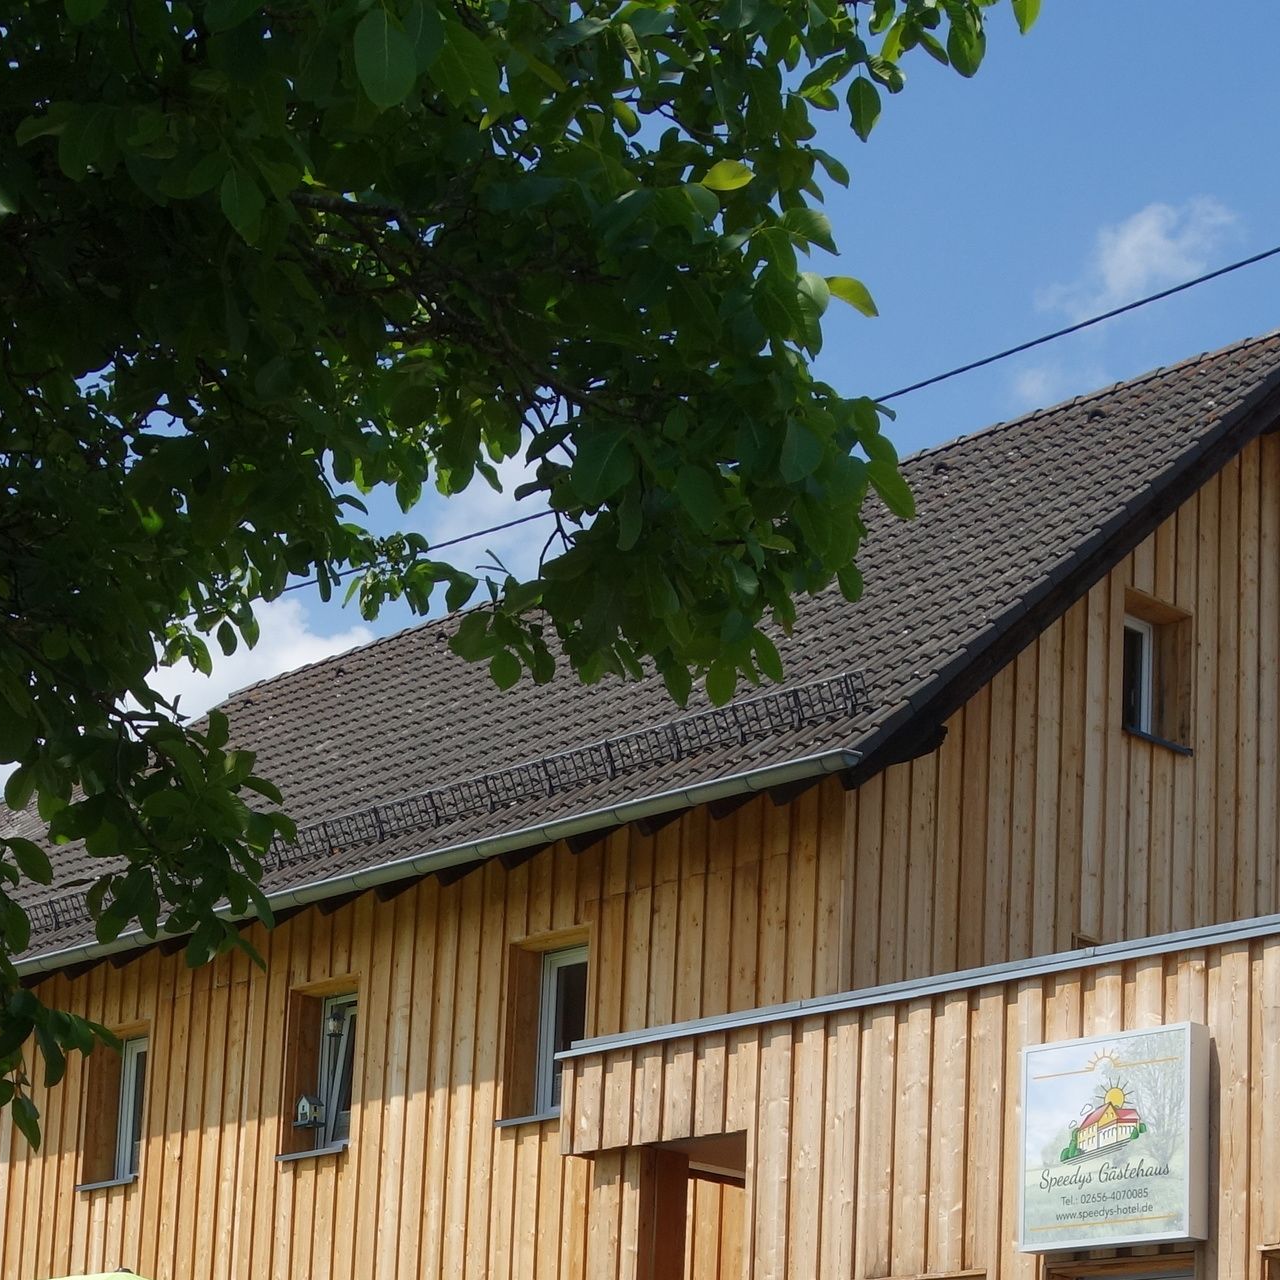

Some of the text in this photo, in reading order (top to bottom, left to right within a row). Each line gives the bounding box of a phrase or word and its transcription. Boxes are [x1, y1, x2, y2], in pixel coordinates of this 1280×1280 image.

[1039, 1158, 1170, 1193] Speedys Gästehaus
[1061, 1188, 1149, 1206] Tel.: 02656-4070085
[1055, 1203, 1154, 1221] www.speedys-hotel.de
